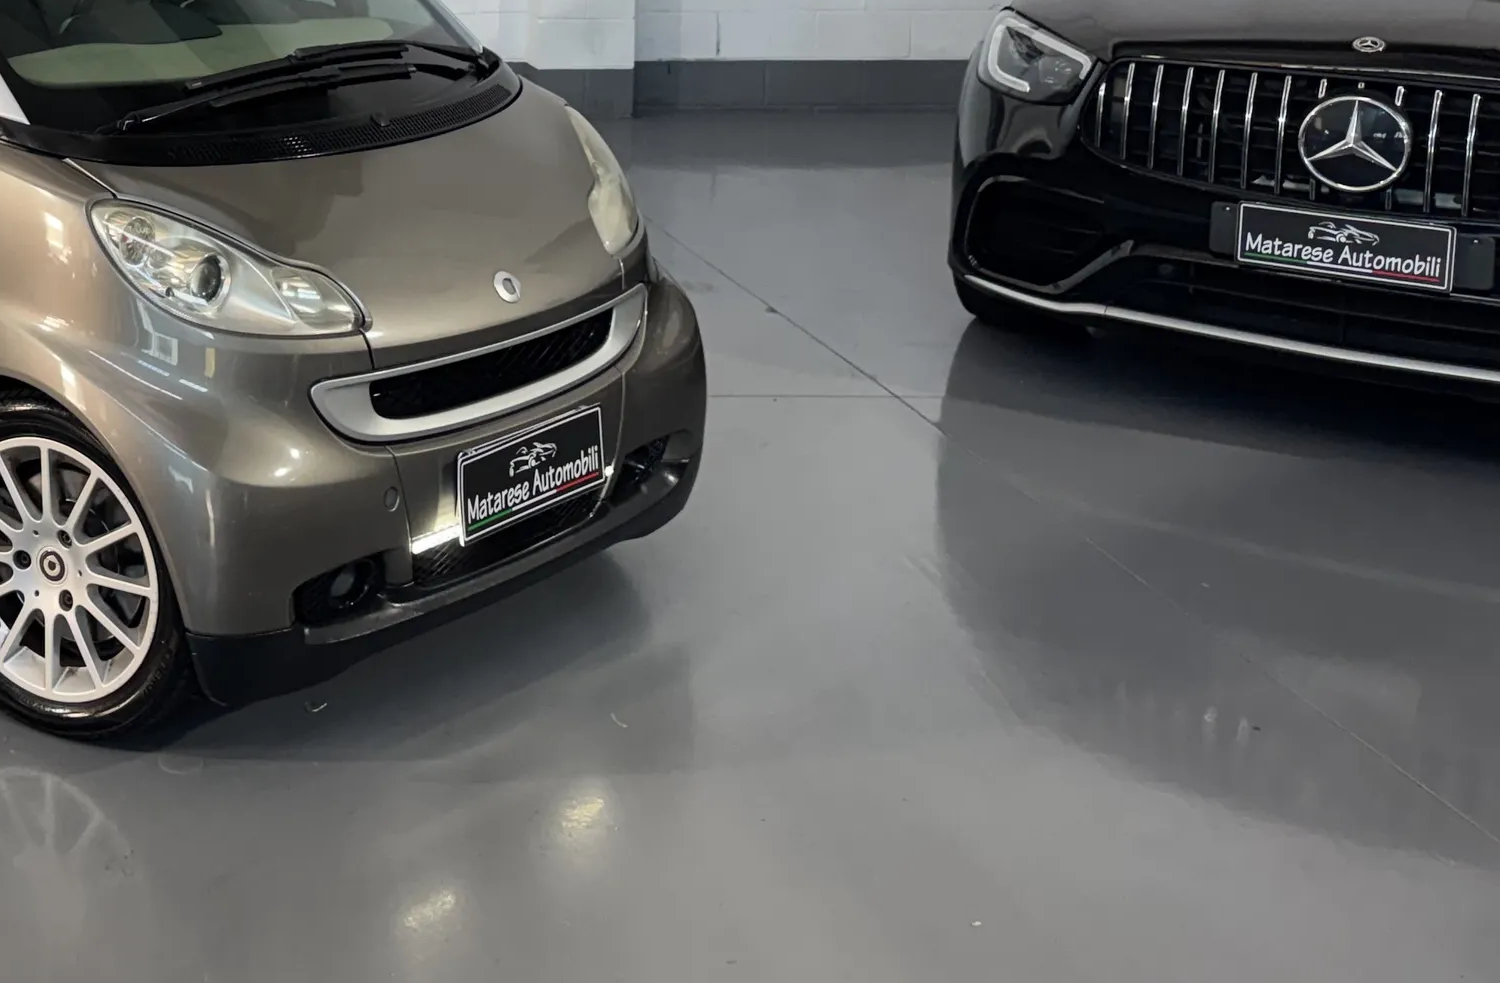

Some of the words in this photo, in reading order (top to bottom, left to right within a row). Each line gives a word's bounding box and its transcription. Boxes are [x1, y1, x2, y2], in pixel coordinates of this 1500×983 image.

[1245, 232, 1333, 262] Matarese
[1338, 245, 1441, 278] Automobili
[467, 481, 530, 524] Matarese
[532, 445, 599, 496] Automobili
